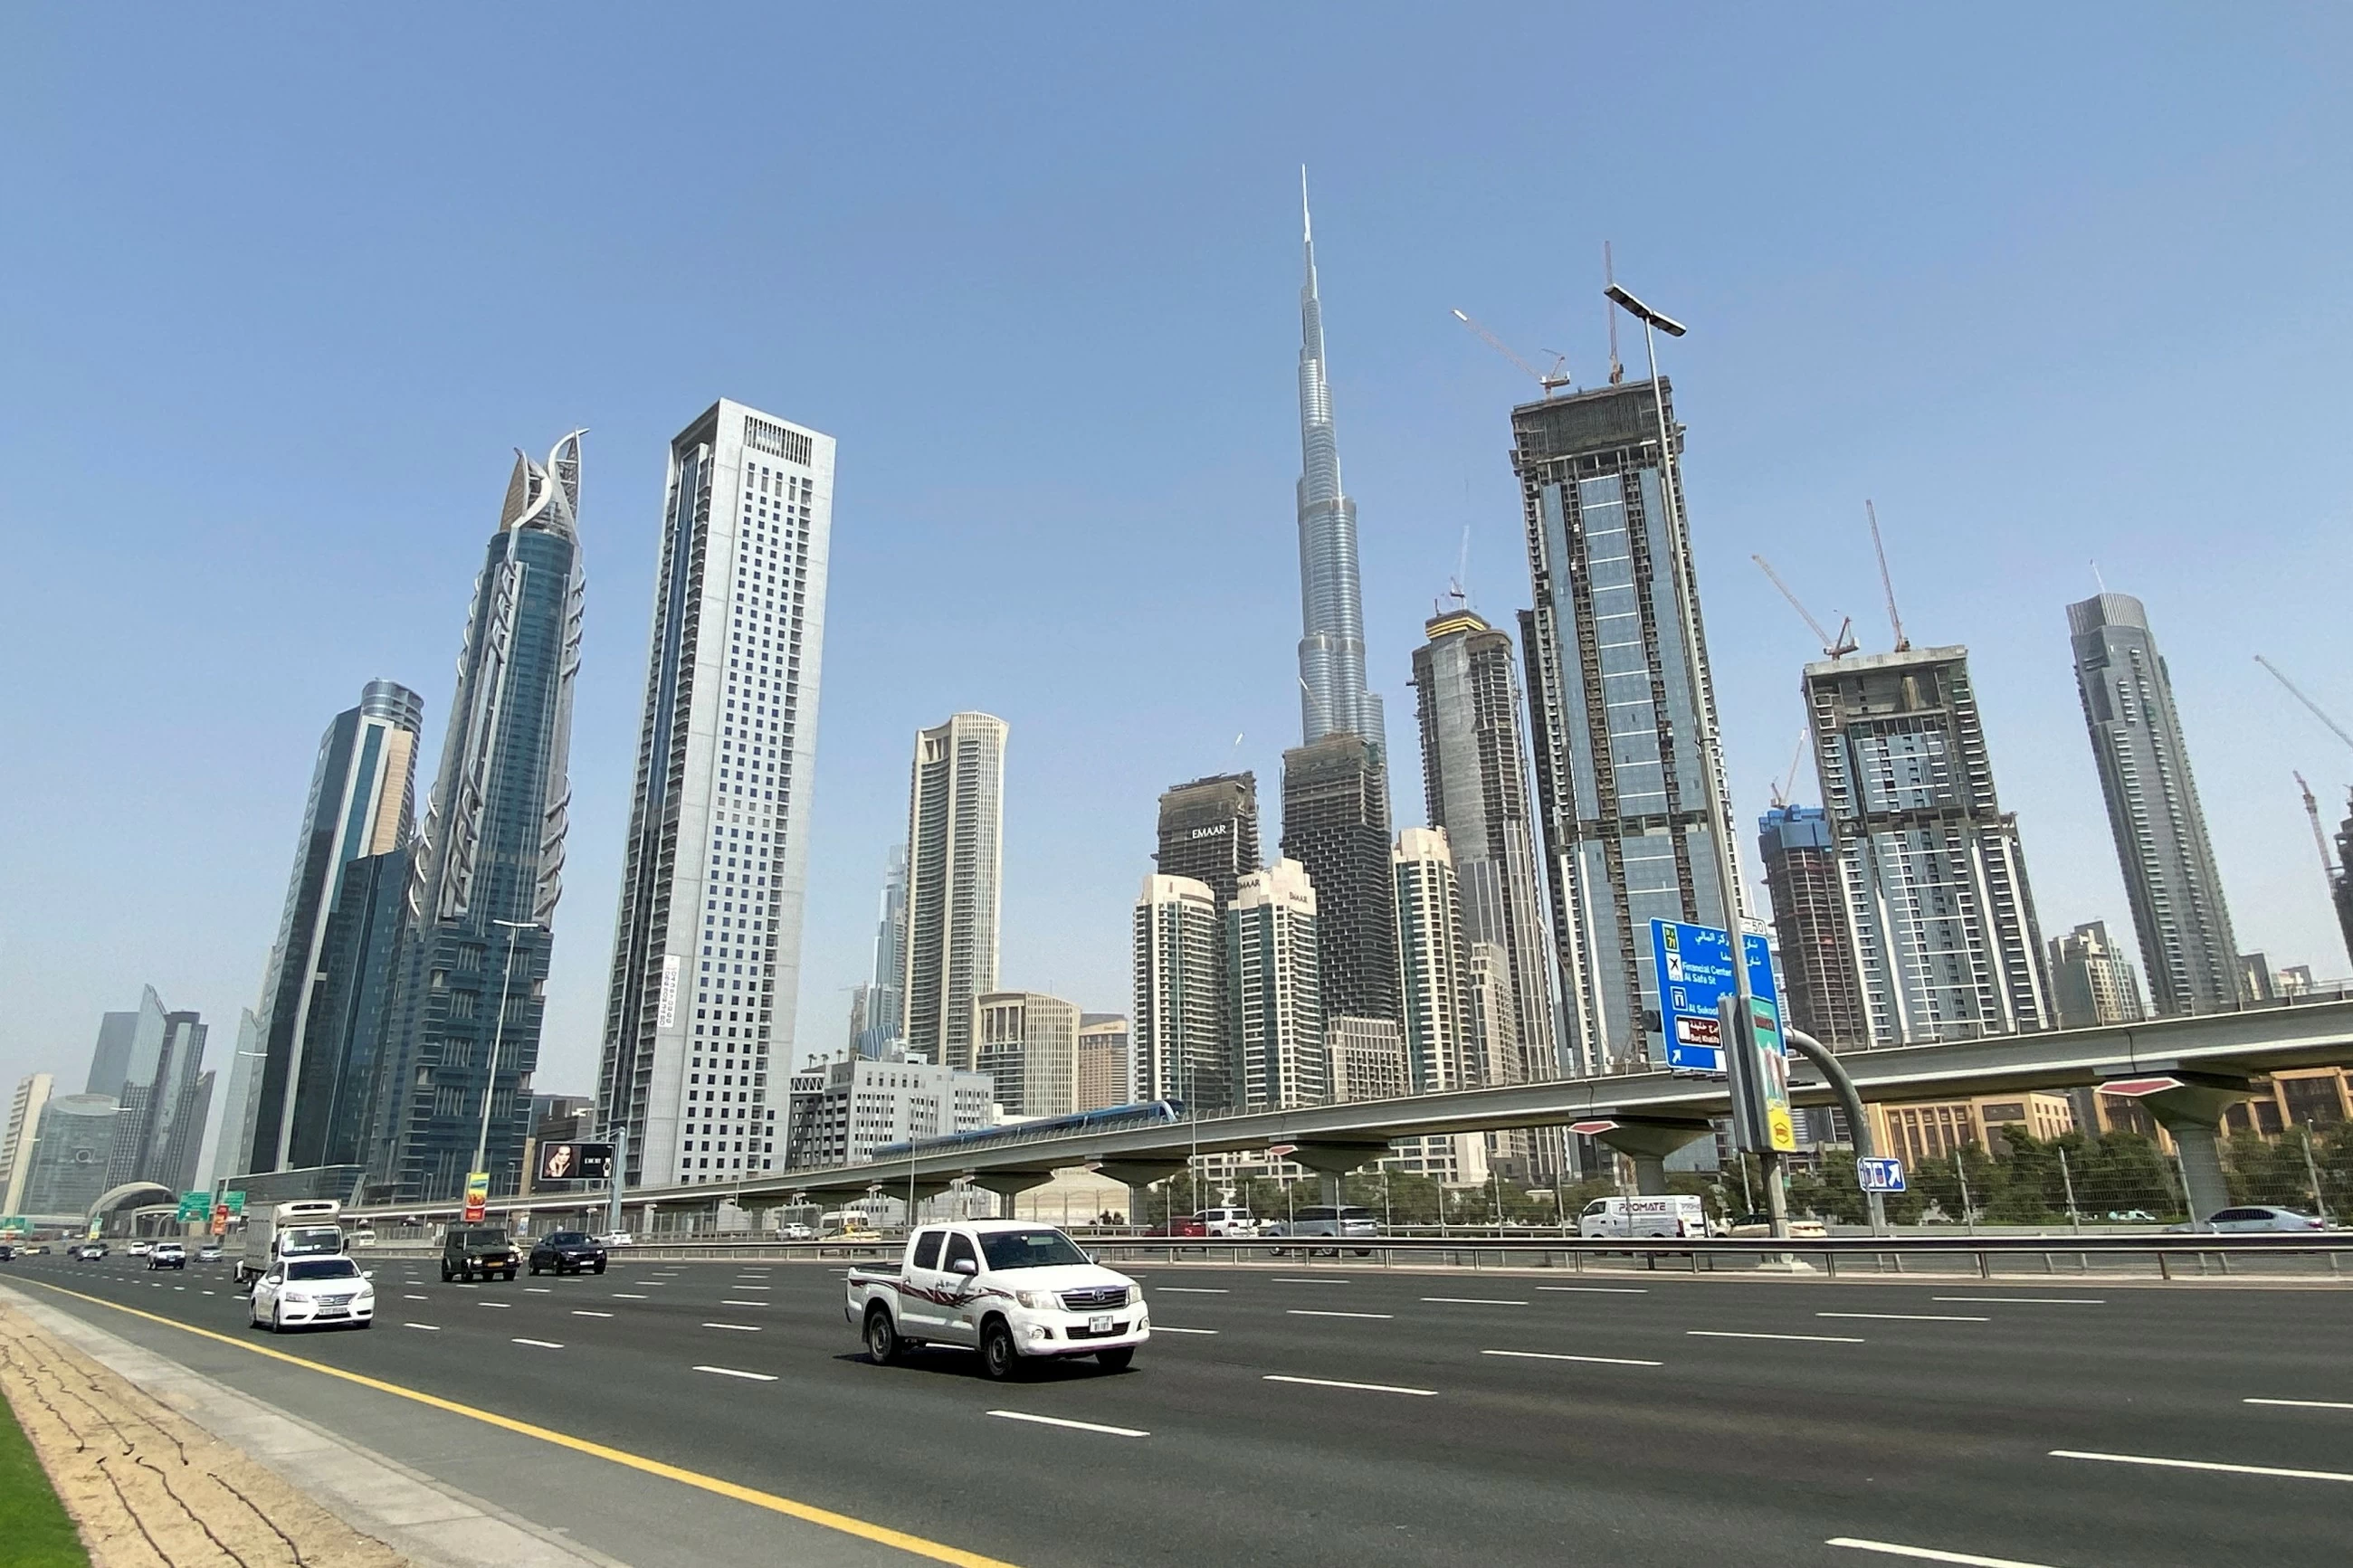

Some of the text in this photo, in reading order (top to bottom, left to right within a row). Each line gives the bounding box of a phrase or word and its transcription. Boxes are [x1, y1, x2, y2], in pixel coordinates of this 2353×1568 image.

[1192, 824, 1226, 839] EMAAR
[1752, 921, 1764, 933] 50
[1682, 961, 1710, 974] Financial
[1692, 973, 1708, 984] Safa
